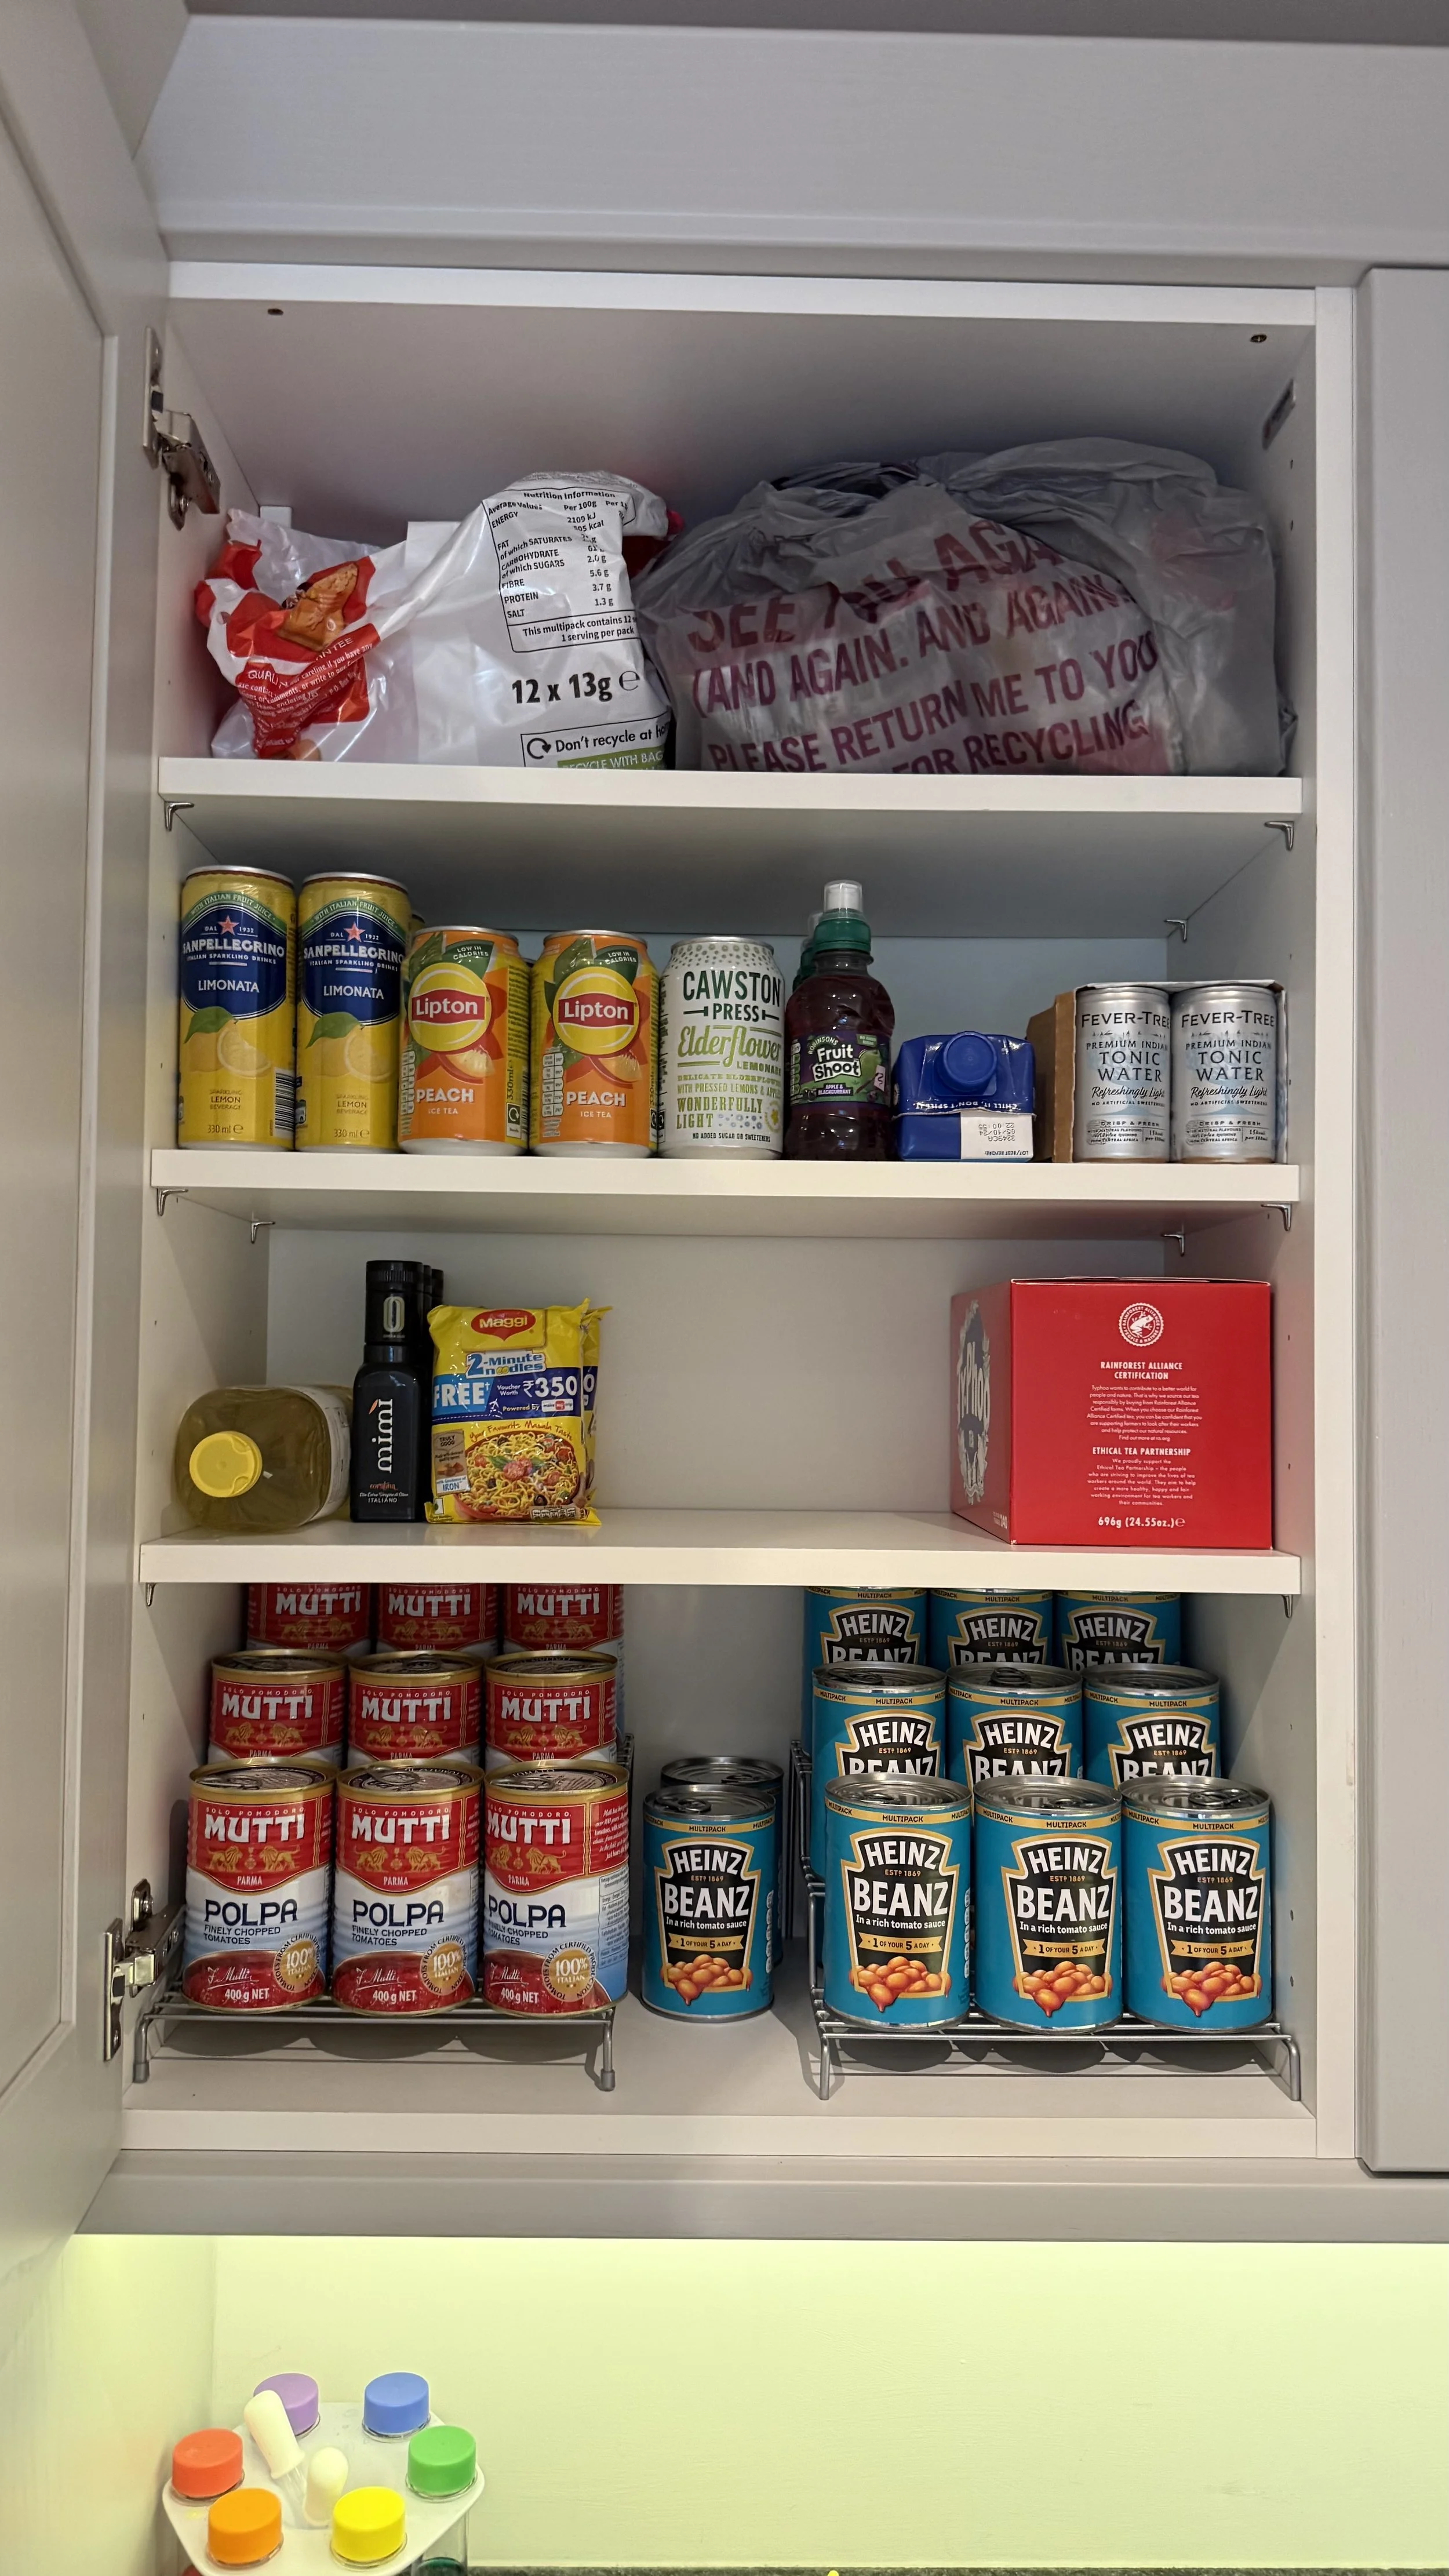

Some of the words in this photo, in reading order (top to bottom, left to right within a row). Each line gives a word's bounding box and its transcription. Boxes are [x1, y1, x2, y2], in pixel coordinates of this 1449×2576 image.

[579, 501, 596, 510] 100g
[492, 511, 519, 528] ENERGY
[497, 540, 509, 551] FAT
[529, 536, 573, 545] SATURATES
[501, 549, 559, 571] CARBOHYDRATE
[534, 559, 565, 570] SUGARS
[604, 569, 609, 577] g
[501, 579, 525, 590] FIBRE
[504, 592, 539, 604] PROTEIN
[507, 609, 525, 618] SALT
[523, 626, 541, 637] This
[543, 622, 585, 634] multipack
[587, 616, 622, 627] contains
[567, 630, 599, 641] serving
[601, 628, 614, 638] per
[617, 626, 635, 636] pack
[361, 643, 373, 653] any
[693, 660, 776, 719] (AND
[789, 628, 909, 702] AGAIN.
[916, 601, 991, 658] AND
[512, 679, 540, 704] 12
[547, 684, 561, 701] x
[569, 672, 613, 703] 13g
[831, 679, 967, 765] RETURN
[970, 674, 1029, 718] ME
[1035, 658, 1085, 704] TO
[555, 736, 589, 752] Don't
[593, 729, 635, 748] recycle
[639, 729, 652, 740] at
[610, 755, 638, 769] WITH
[183, 938, 285, 958] SANPELLEGRINO
[453, 951, 489, 960] CALORIES
[198, 980, 260, 993] LIMONATA
[323, 985, 384, 999] LIMONATA
[683, 970, 781, 1007] CAWSTON
[416, 998, 478, 1018] Lipton
[564, 1001, 628, 1021] Lipton
[712, 1003, 759, 1023] PRESS
[1182, 1010, 1275, 1027] FEVER-TREE
[678, 1025, 782, 1068] Elderflower
[817, 1044, 853, 1062] Fruit
[1186, 1040, 1235, 1050] PREMIUM
[1241, 1040, 1272, 1049] INDIAN
[1099, 1051, 1160, 1065] TONIC
[1198, 1051, 1262, 1064] TONIC
[815, 1061, 859, 1079] Shoot
[1098, 1068, 1162, 1082] WATER
[1196, 1067, 1264, 1082] WATER
[416, 1087, 474, 1103] PEACH
[566, 1091, 626, 1107] PEACH
[1190, 1086, 1247, 1098] Refreshingly
[677, 1097, 763, 1114] WONDERFULLY
[677, 1113, 713, 1129] LIGHT
[479, 1315, 528, 1329] Maggi
[485, 1363, 543, 1375] noodles
[1093, 1447, 1122, 1455] ETHICAL
[443, 1483, 460, 1491] IRON
[1098, 1516, 1122, 1528] 696g
[1126, 1517, 1174, 1528] (24.55oz.)
[275, 1591, 361, 1616] MUTTI
[388, 1593, 471, 1617] MUTTI
[518, 1592, 599, 1616] MUTTI
[842, 1614, 906, 1638] HEINZ
[969, 1618, 1035, 1641] HEINZ
[1079, 1617, 1145, 1642] HEINZ
[221, 1693, 313, 1720] MUTTI
[361, 1695, 452, 1723] MUTTI
[501, 1695, 591, 1722] MUTTI
[858, 1721, 927, 1747] HEINZ
[984, 1722, 1055, 1749] HEINZ
[1133, 1724, 1202, 1749] HEINZ
[205, 1814, 305, 1843] MUTTI
[351, 1814, 450, 1843] MUTTI
[487, 1810, 570, 1844] MUTTI
[673, 1849, 742, 1875] HEINZ
[864, 1841, 940, 1870] HEINZ
[1027, 1847, 1102, 1874] HEINZ
[1174, 1849, 1250, 1875] HEINZ
[237, 1876, 263, 1886] PARMA
[508, 1875, 530, 1886] PARMA
[664, 1883, 750, 1918] BEANZ
[854, 1877, 949, 1917] BEANZ
[1017, 1884, 1109, 1922] BEANZ
[1164, 1886, 1258, 1922] BEANZ
[205, 1899, 298, 1926] POLPA
[353, 1900, 444, 1927] POLPA
[489, 1894, 566, 1929] POLPA
[205, 1924, 233, 1935] FINELY
[234, 1926, 281, 1936] CHOPPED
[872, 1918, 889, 1928] rich
[891, 1919, 922, 1929] tomato
[924, 1918, 945, 1929] sauce
[1206, 1925, 1236, 1935] tomato
[1237, 1923, 1256, 1933] sauce
[203, 1933, 250, 1945] TOMATOES
[905, 1941, 912, 1951] 5
[556, 1958, 588, 1977] 100%
[557, 1975, 585, 1984] ITALIAN
[225, 1989, 242, 1999] 400
[243, 1992, 249, 2003] g
[252, 1988, 270, 1999] NET
